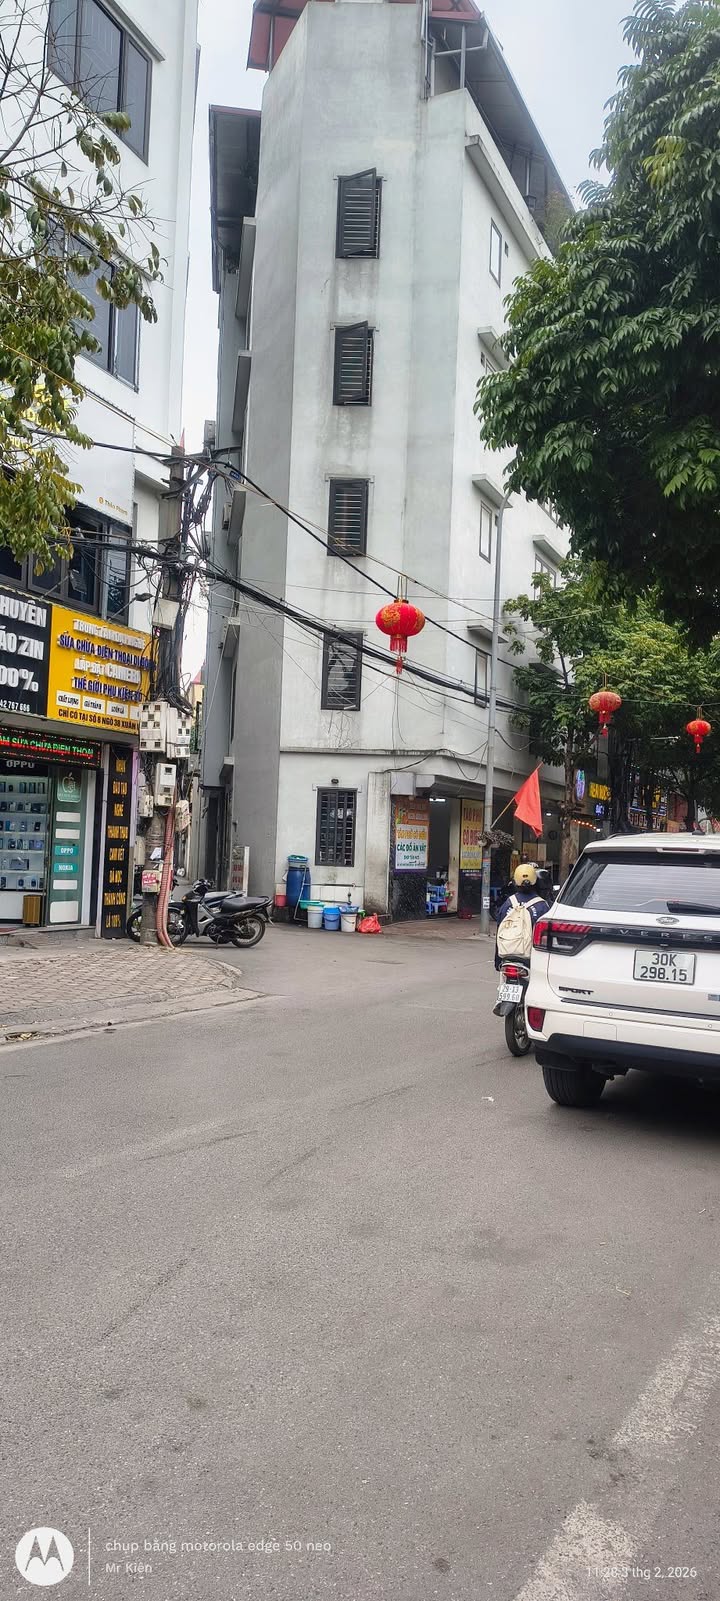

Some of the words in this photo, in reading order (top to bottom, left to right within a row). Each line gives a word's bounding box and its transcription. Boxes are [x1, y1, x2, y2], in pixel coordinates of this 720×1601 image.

[17, 635, 45, 661] ZIN
[57, 630, 75, 649] SỬA
[75, 637, 95, 655] CHỮA
[95, 643, 113, 661] ĐIỆN
[114, 648, 133, 666] THOẠI
[71, 674, 87, 690] THẾ
[87, 677, 102, 692] GIỚI
[102, 682, 117, 699] PHỤ
[58, 708, 69, 719] CHỈ
[70, 710, 78, 720] CÓ
[79, 712, 88, 722] TẠI
[89, 713, 97, 723] SỐ
[102, 717, 113, 727] NGÕ
[114, 718, 121, 728] 38
[6, 759, 35, 769] OPPO
[59, 864, 73, 872] NOKIA
[651, 952, 678, 967] 30K
[640, 966, 688, 982] 298.15
[558, 986, 595, 996] SPORT
